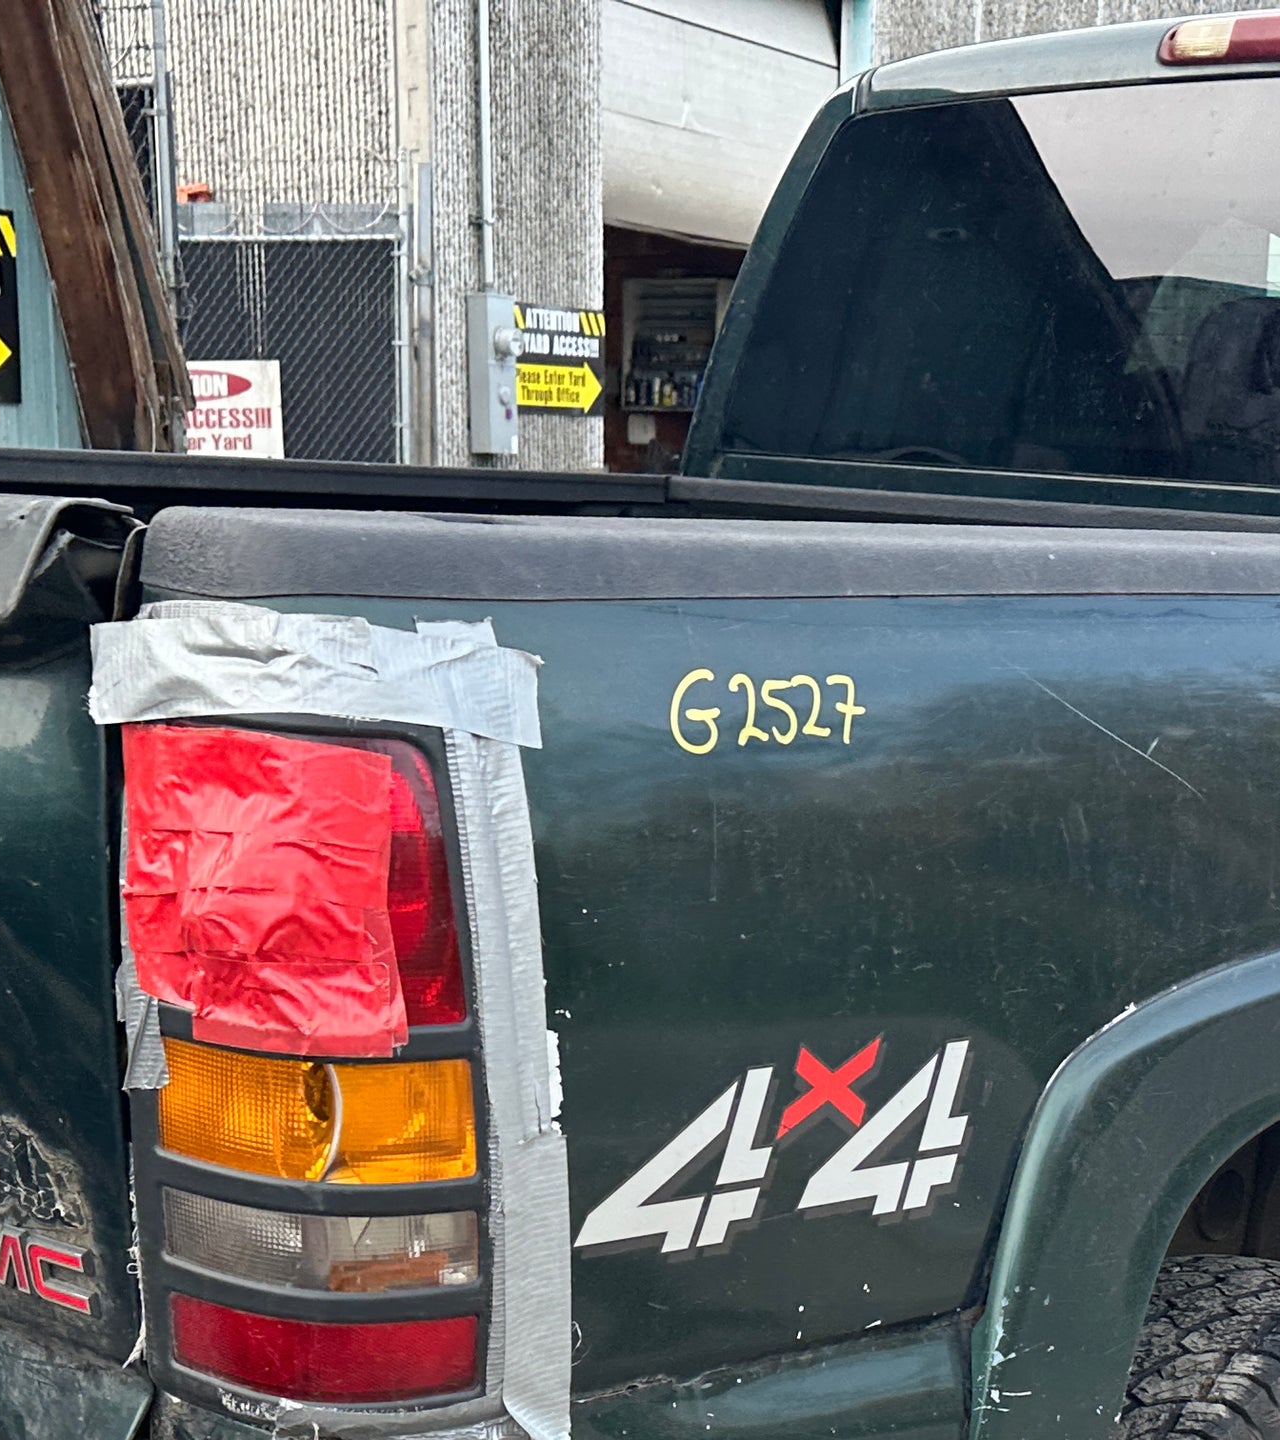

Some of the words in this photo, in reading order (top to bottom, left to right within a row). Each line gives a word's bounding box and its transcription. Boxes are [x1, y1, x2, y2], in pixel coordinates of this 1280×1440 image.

[525, 307, 581, 333] ATTENTION
[523, 332, 551, 355] YARD
[552, 334, 600, 358] ACCESS!!!
[190, 374, 229, 398] ION
[516, 367, 541, 384] Please
[543, 369, 566, 386] Enter
[569, 370, 587, 387] Yard
[521, 385, 554, 404] Through
[556, 387, 581, 404] Office
[211, 432, 253, 451] Yard
[668, 667, 867, 756] G2527
